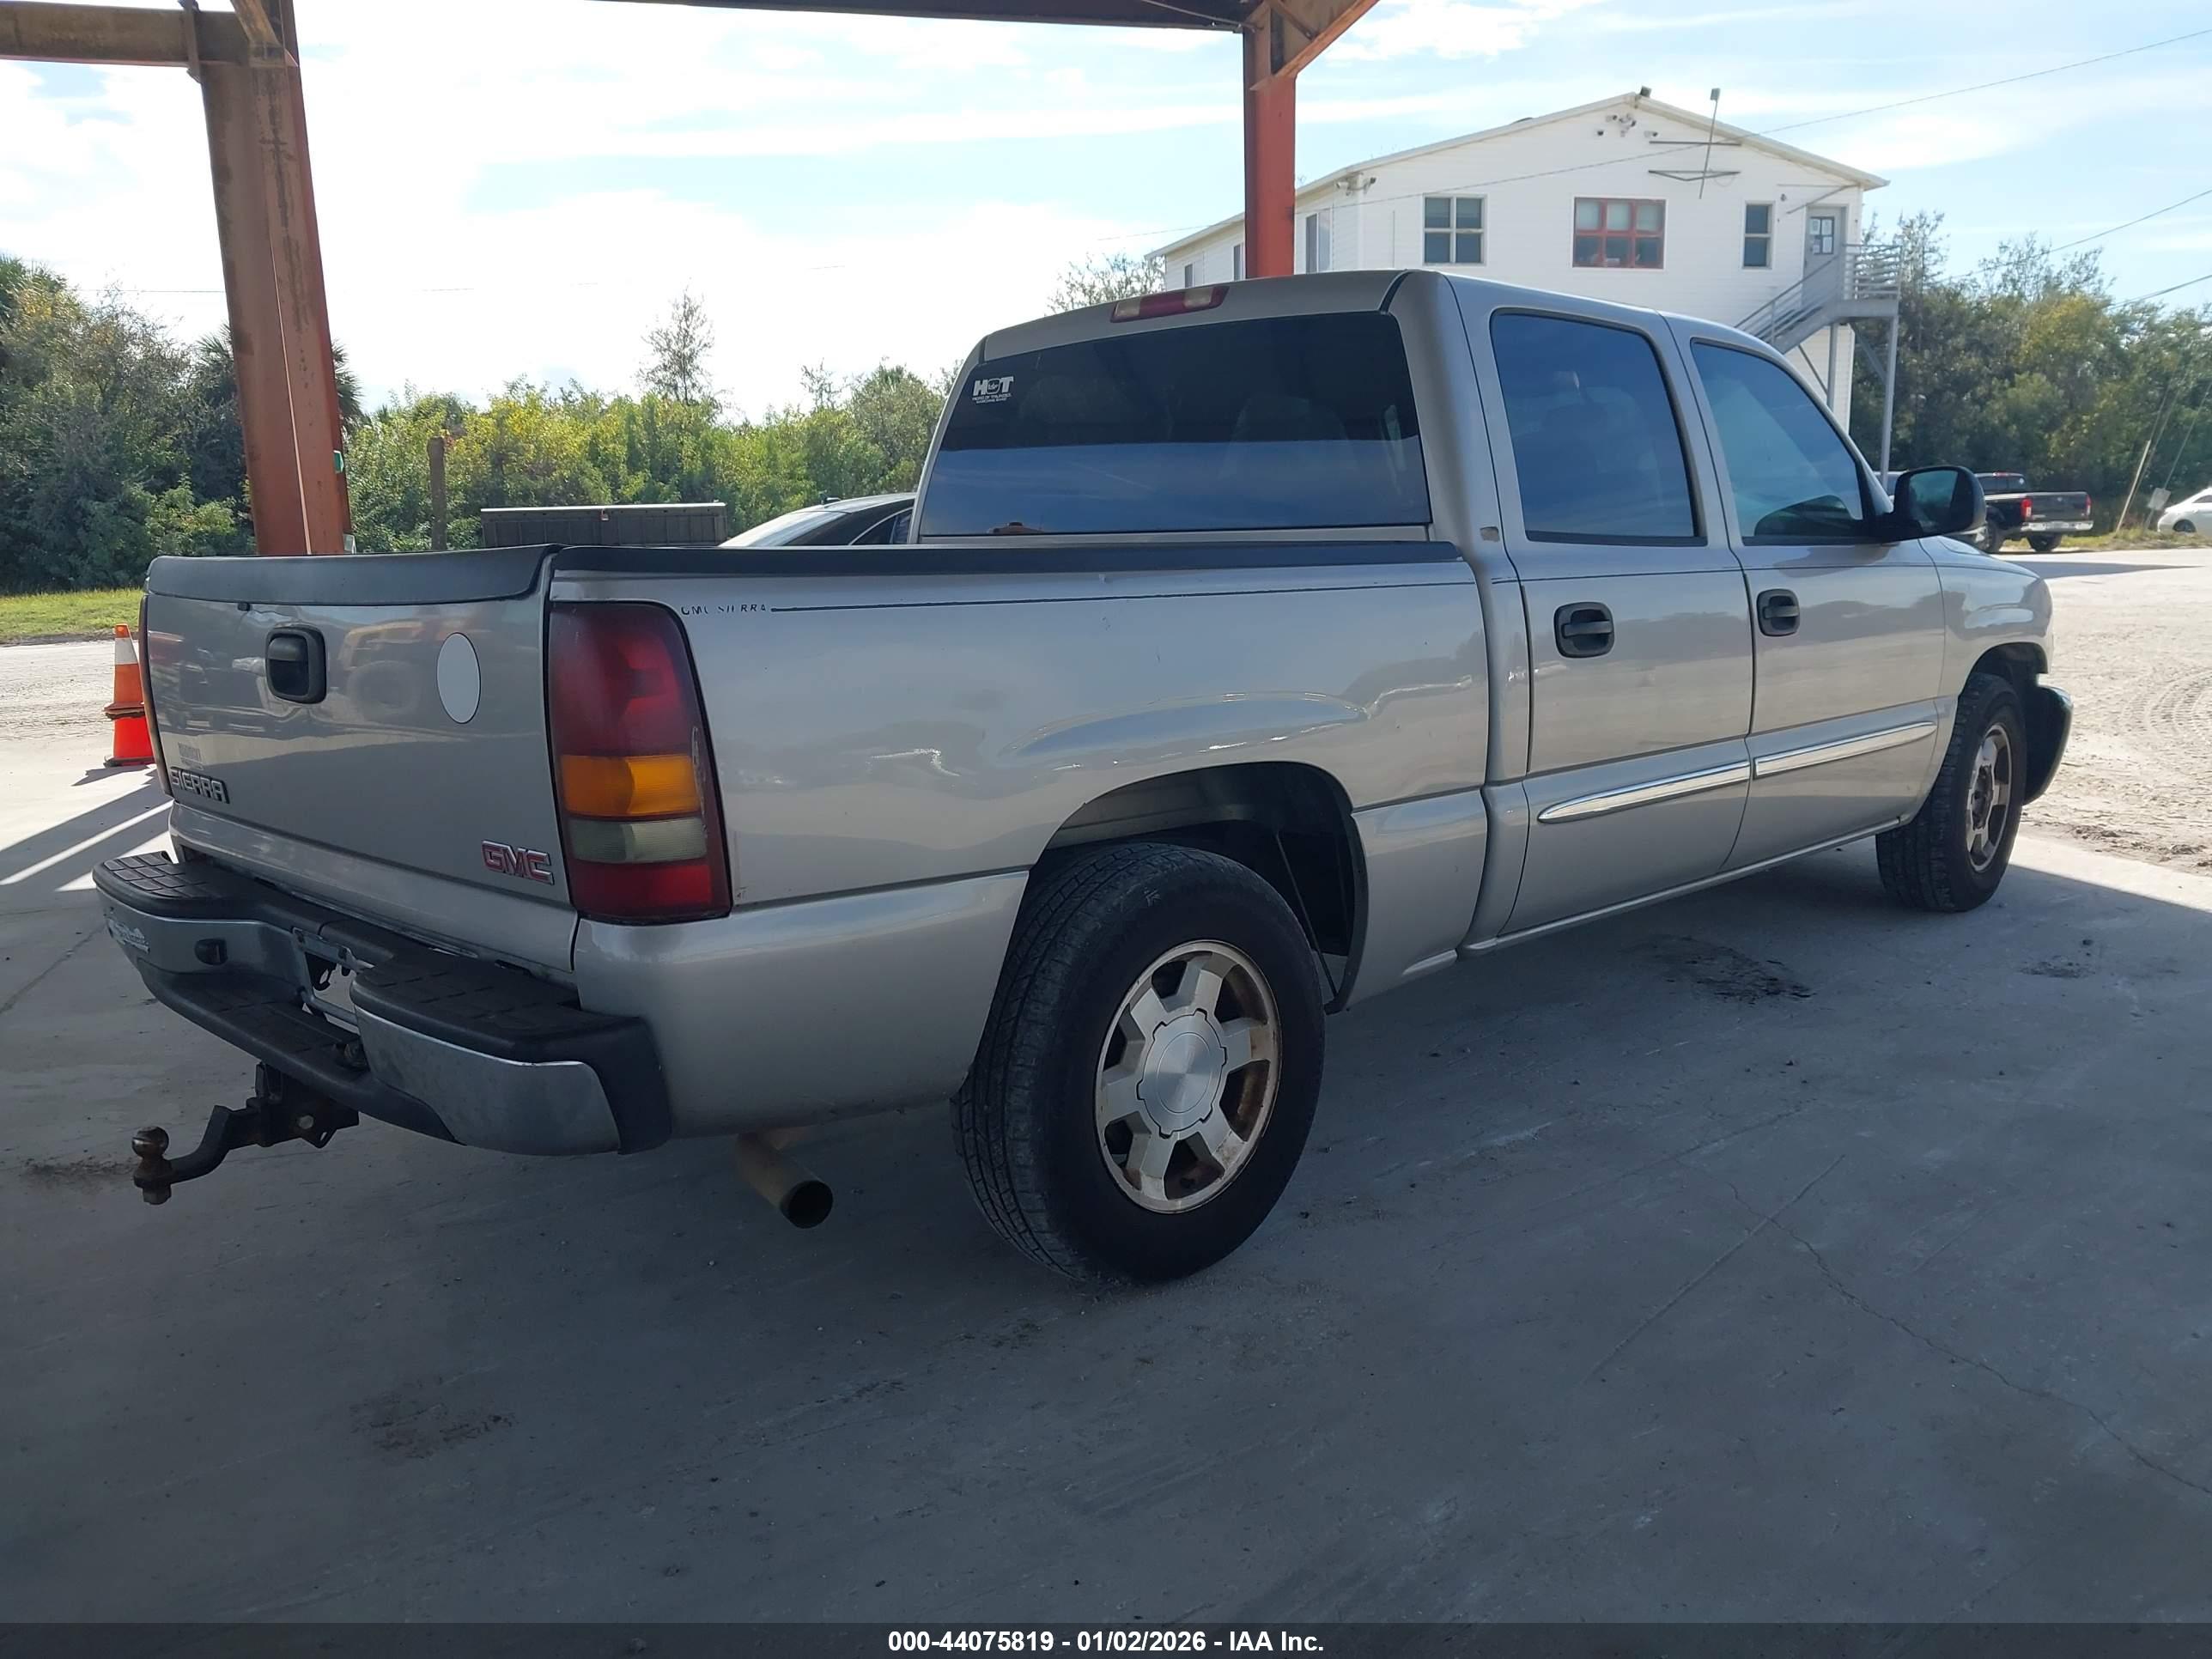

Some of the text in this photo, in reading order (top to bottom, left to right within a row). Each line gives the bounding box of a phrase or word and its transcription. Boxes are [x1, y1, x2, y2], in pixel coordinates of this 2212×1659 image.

[973, 376, 1013, 396] HOT
[170, 767, 230, 804] SIERRA
[482, 840, 555, 886] GMC
